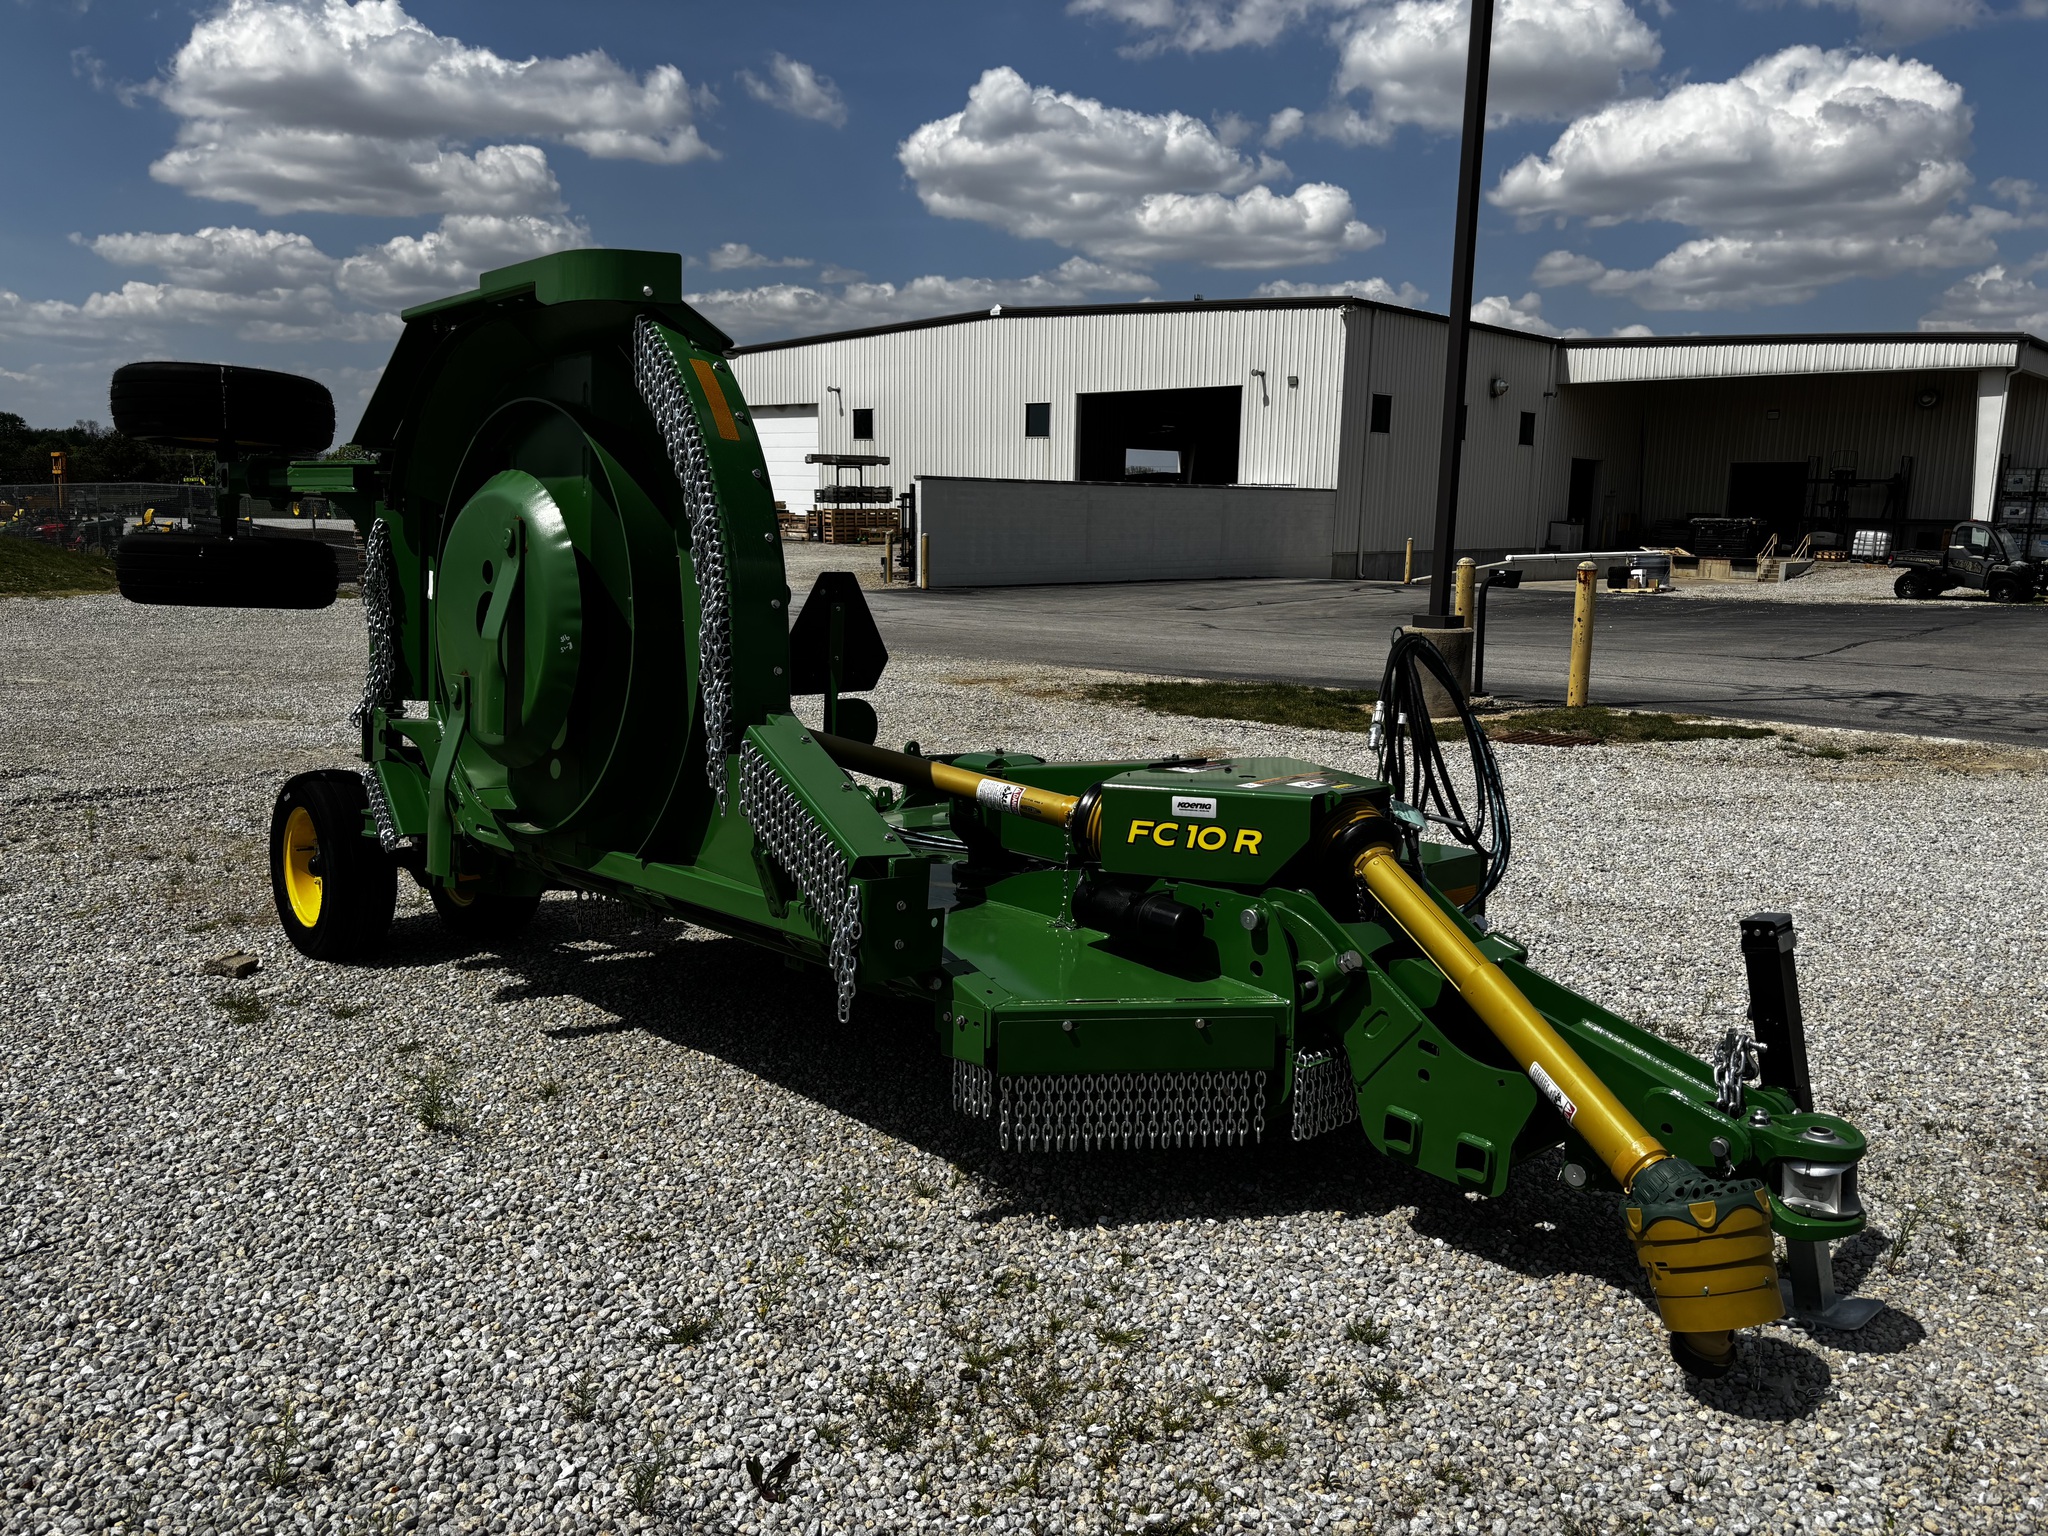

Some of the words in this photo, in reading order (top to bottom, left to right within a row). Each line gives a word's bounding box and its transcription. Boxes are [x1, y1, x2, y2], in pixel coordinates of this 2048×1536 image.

[1126, 819, 1179, 847] FC
[1186, 824, 1228, 851] 10
[1233, 828, 1263, 855] R
